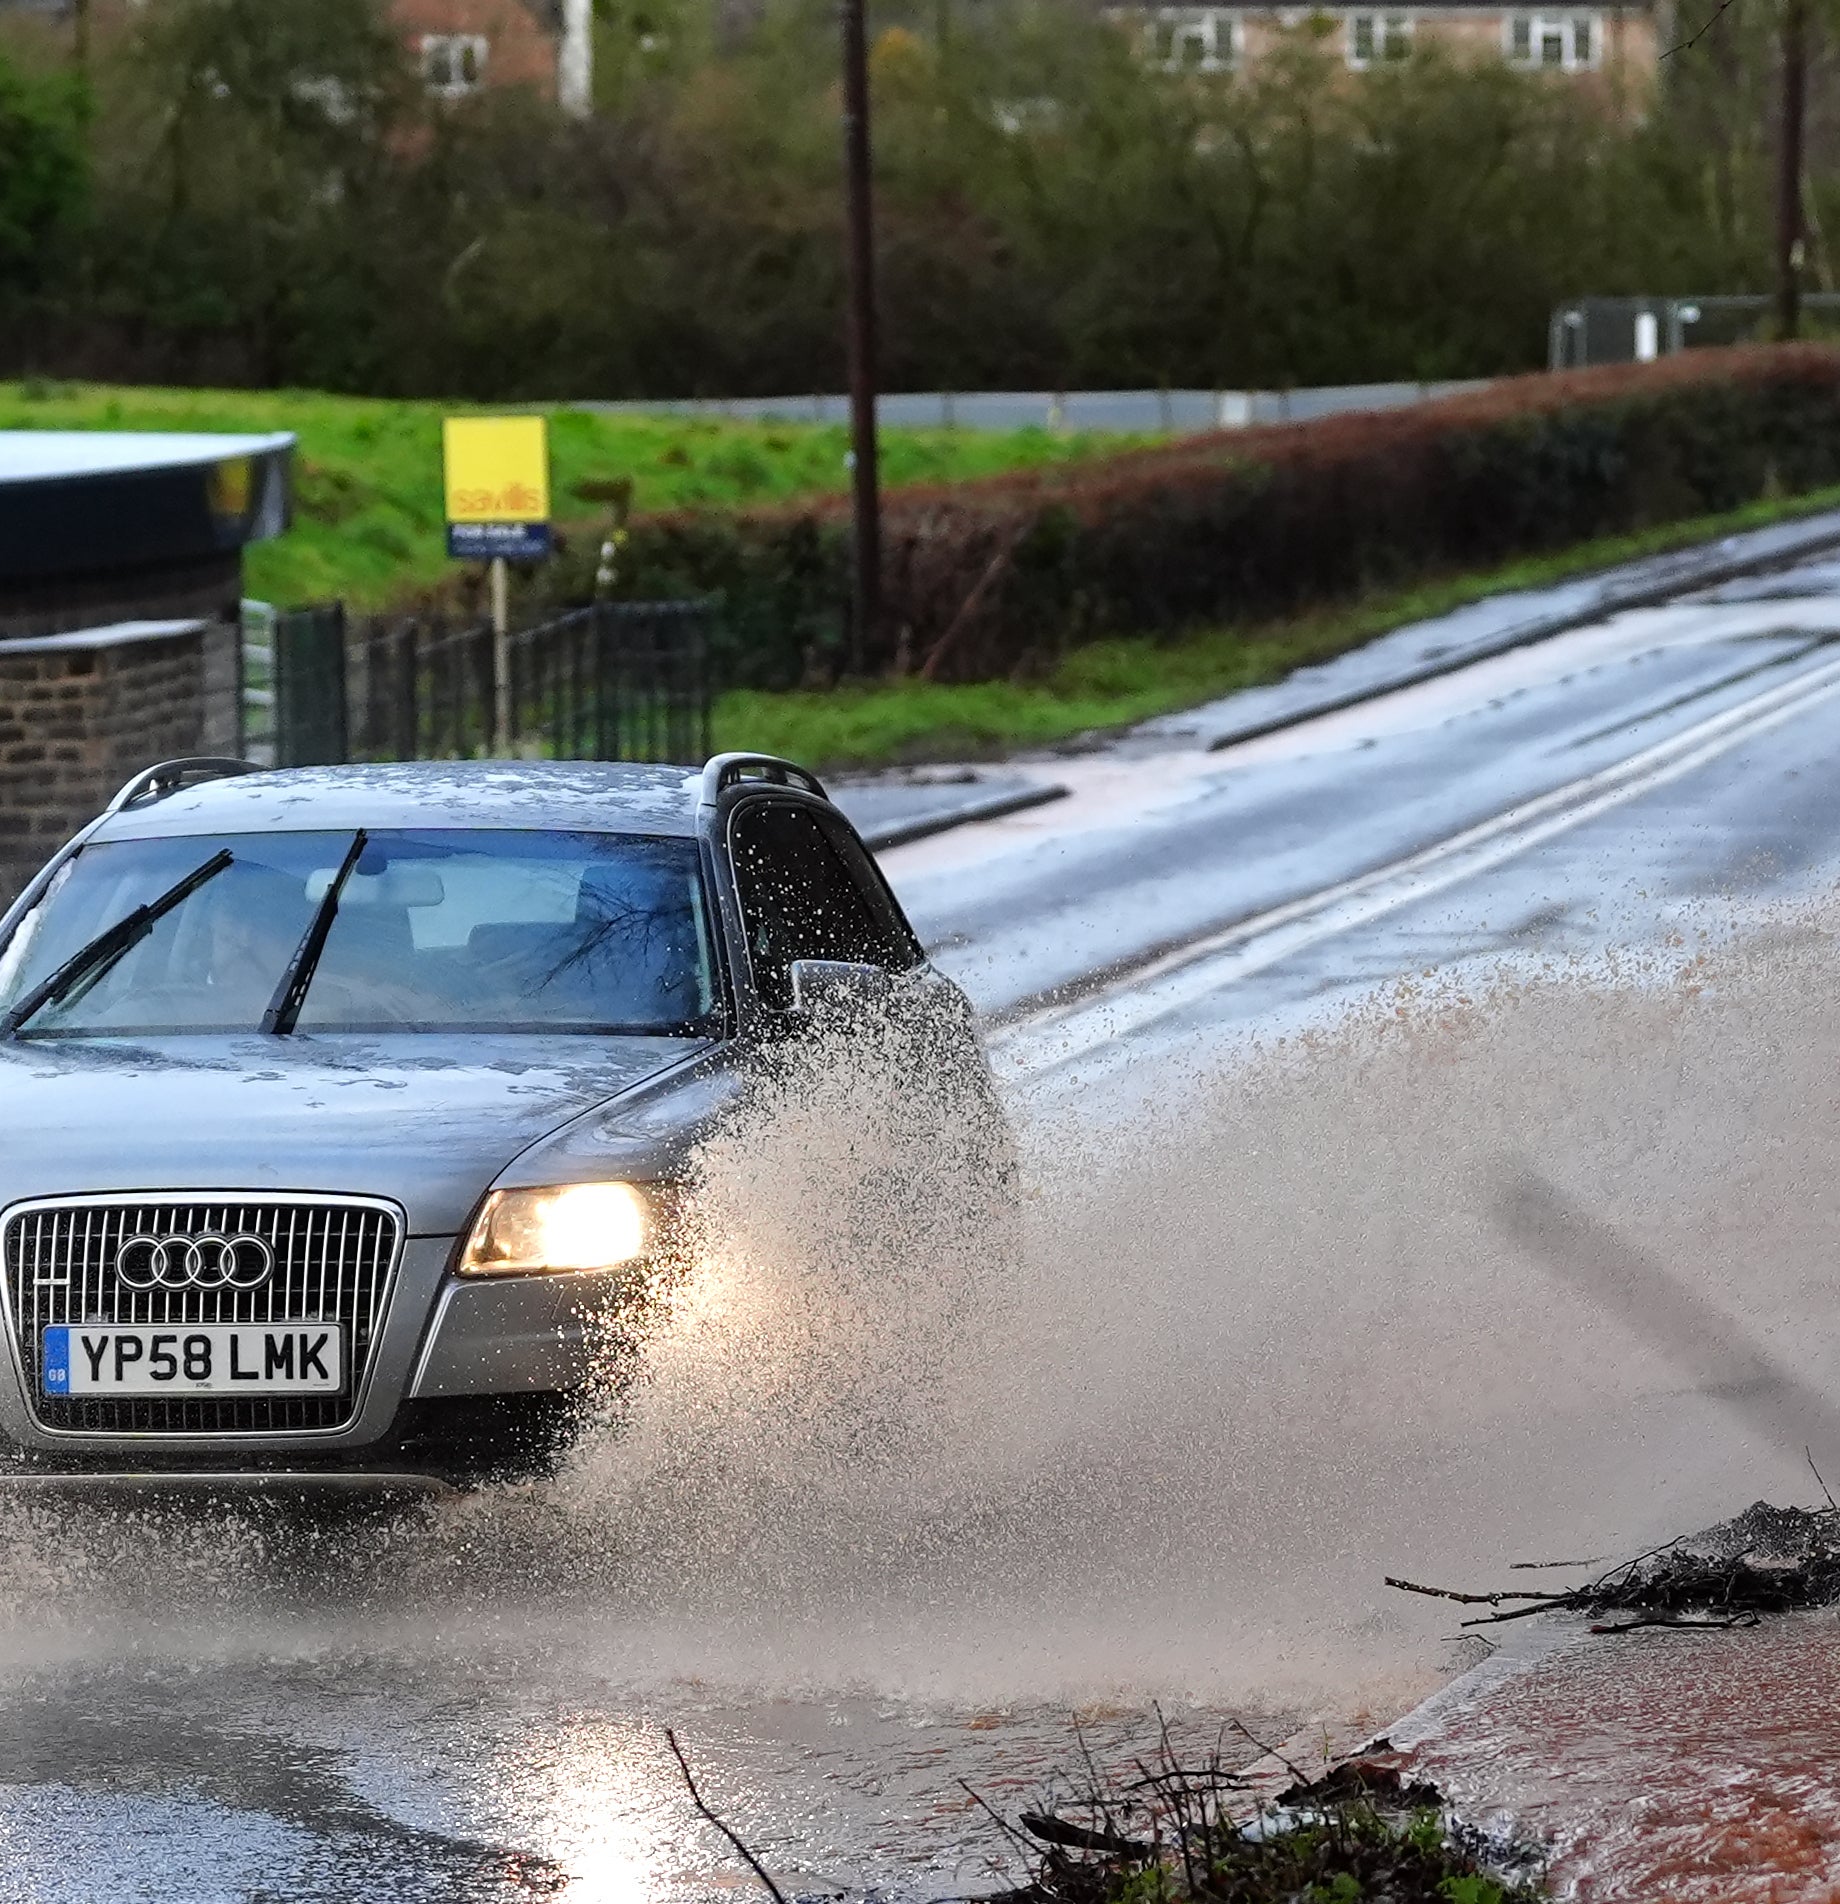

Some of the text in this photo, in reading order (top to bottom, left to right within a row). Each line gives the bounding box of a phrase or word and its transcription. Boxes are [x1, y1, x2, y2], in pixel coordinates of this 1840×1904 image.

[80, 1334, 329, 1381] YP58 LMK
[48, 1368, 66, 1382] GB
